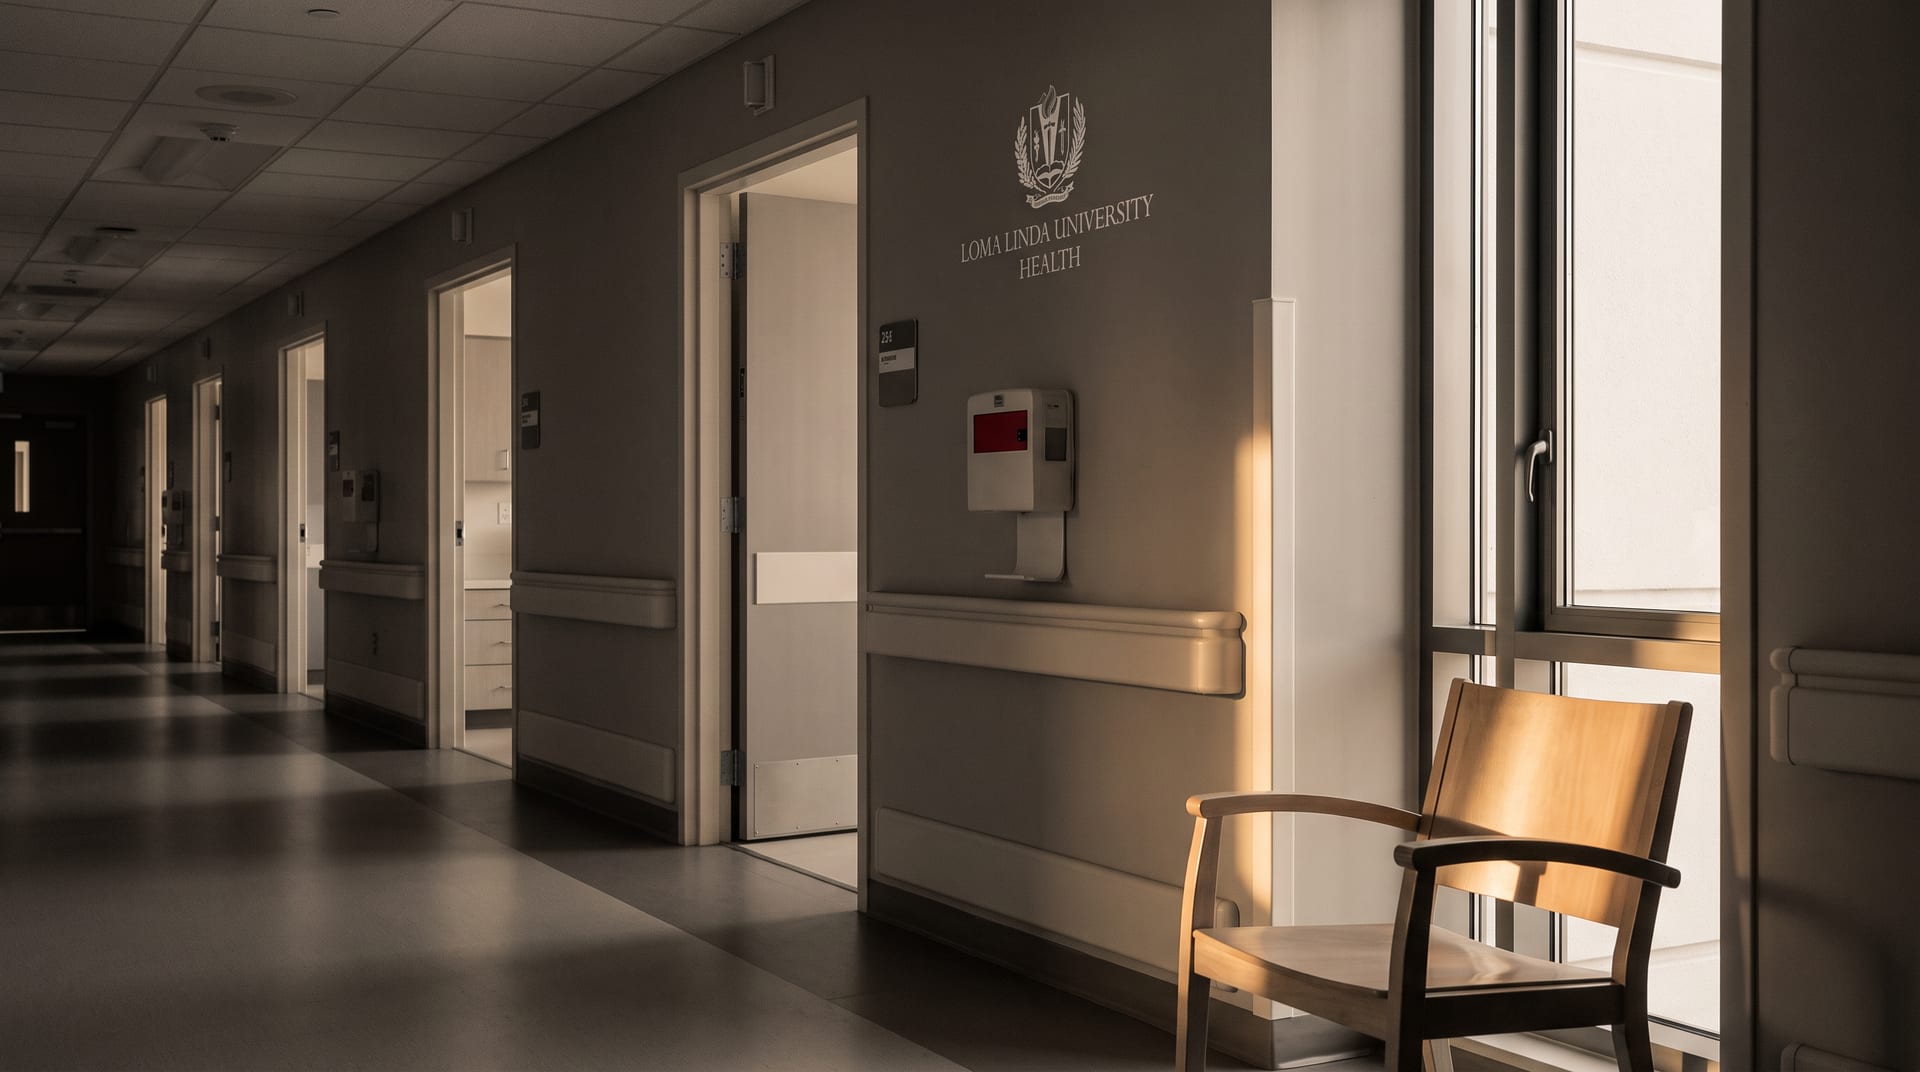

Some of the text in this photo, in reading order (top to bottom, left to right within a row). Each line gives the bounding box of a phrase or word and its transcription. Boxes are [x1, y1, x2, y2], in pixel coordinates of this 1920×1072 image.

[961, 235, 1002, 263] LOMA
[1004, 222, 1051, 252] LINDA
[1054, 194, 1154, 240] UNIVERSITY
[1019, 245, 1081, 280] HEALTH
